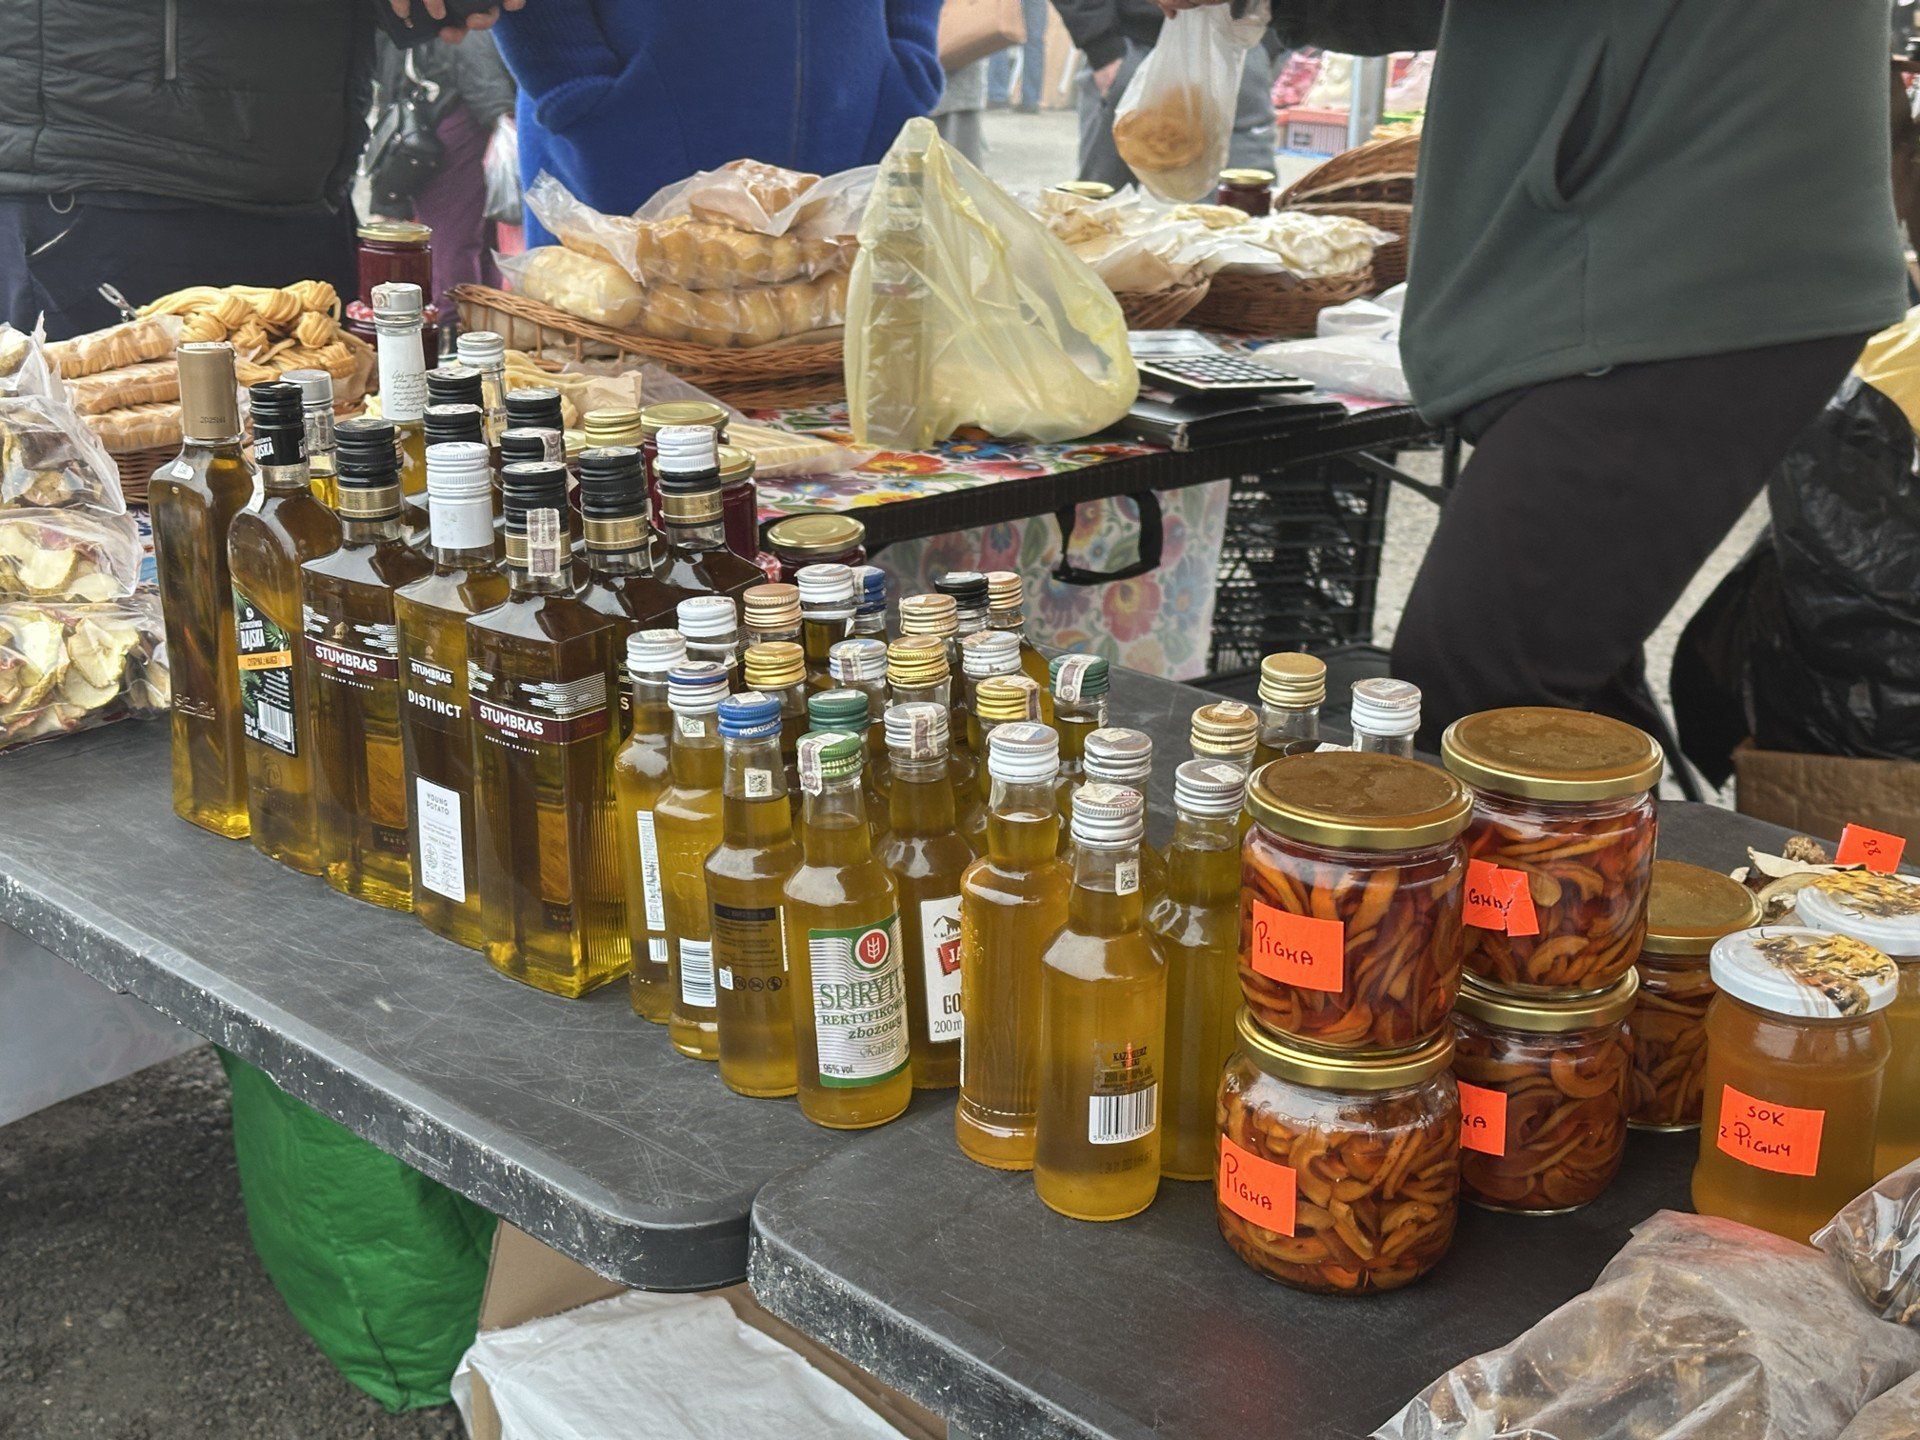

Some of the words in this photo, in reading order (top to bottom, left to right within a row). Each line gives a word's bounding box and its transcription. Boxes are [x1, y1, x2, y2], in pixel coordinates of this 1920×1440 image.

[315, 645, 378, 672] STUMBRAS
[411, 662, 452, 684] STUMBRAS
[408, 689, 462, 718] DISTINCT
[479, 704, 544, 735] STUMBRAS
[426, 792, 448, 807] YOUNG
[426, 800, 450, 816] POTATO
[819, 967, 905, 1011] SPIRYTU
[934, 1020, 953, 1034] 200
[1747, 1106, 1784, 1127] SOK
